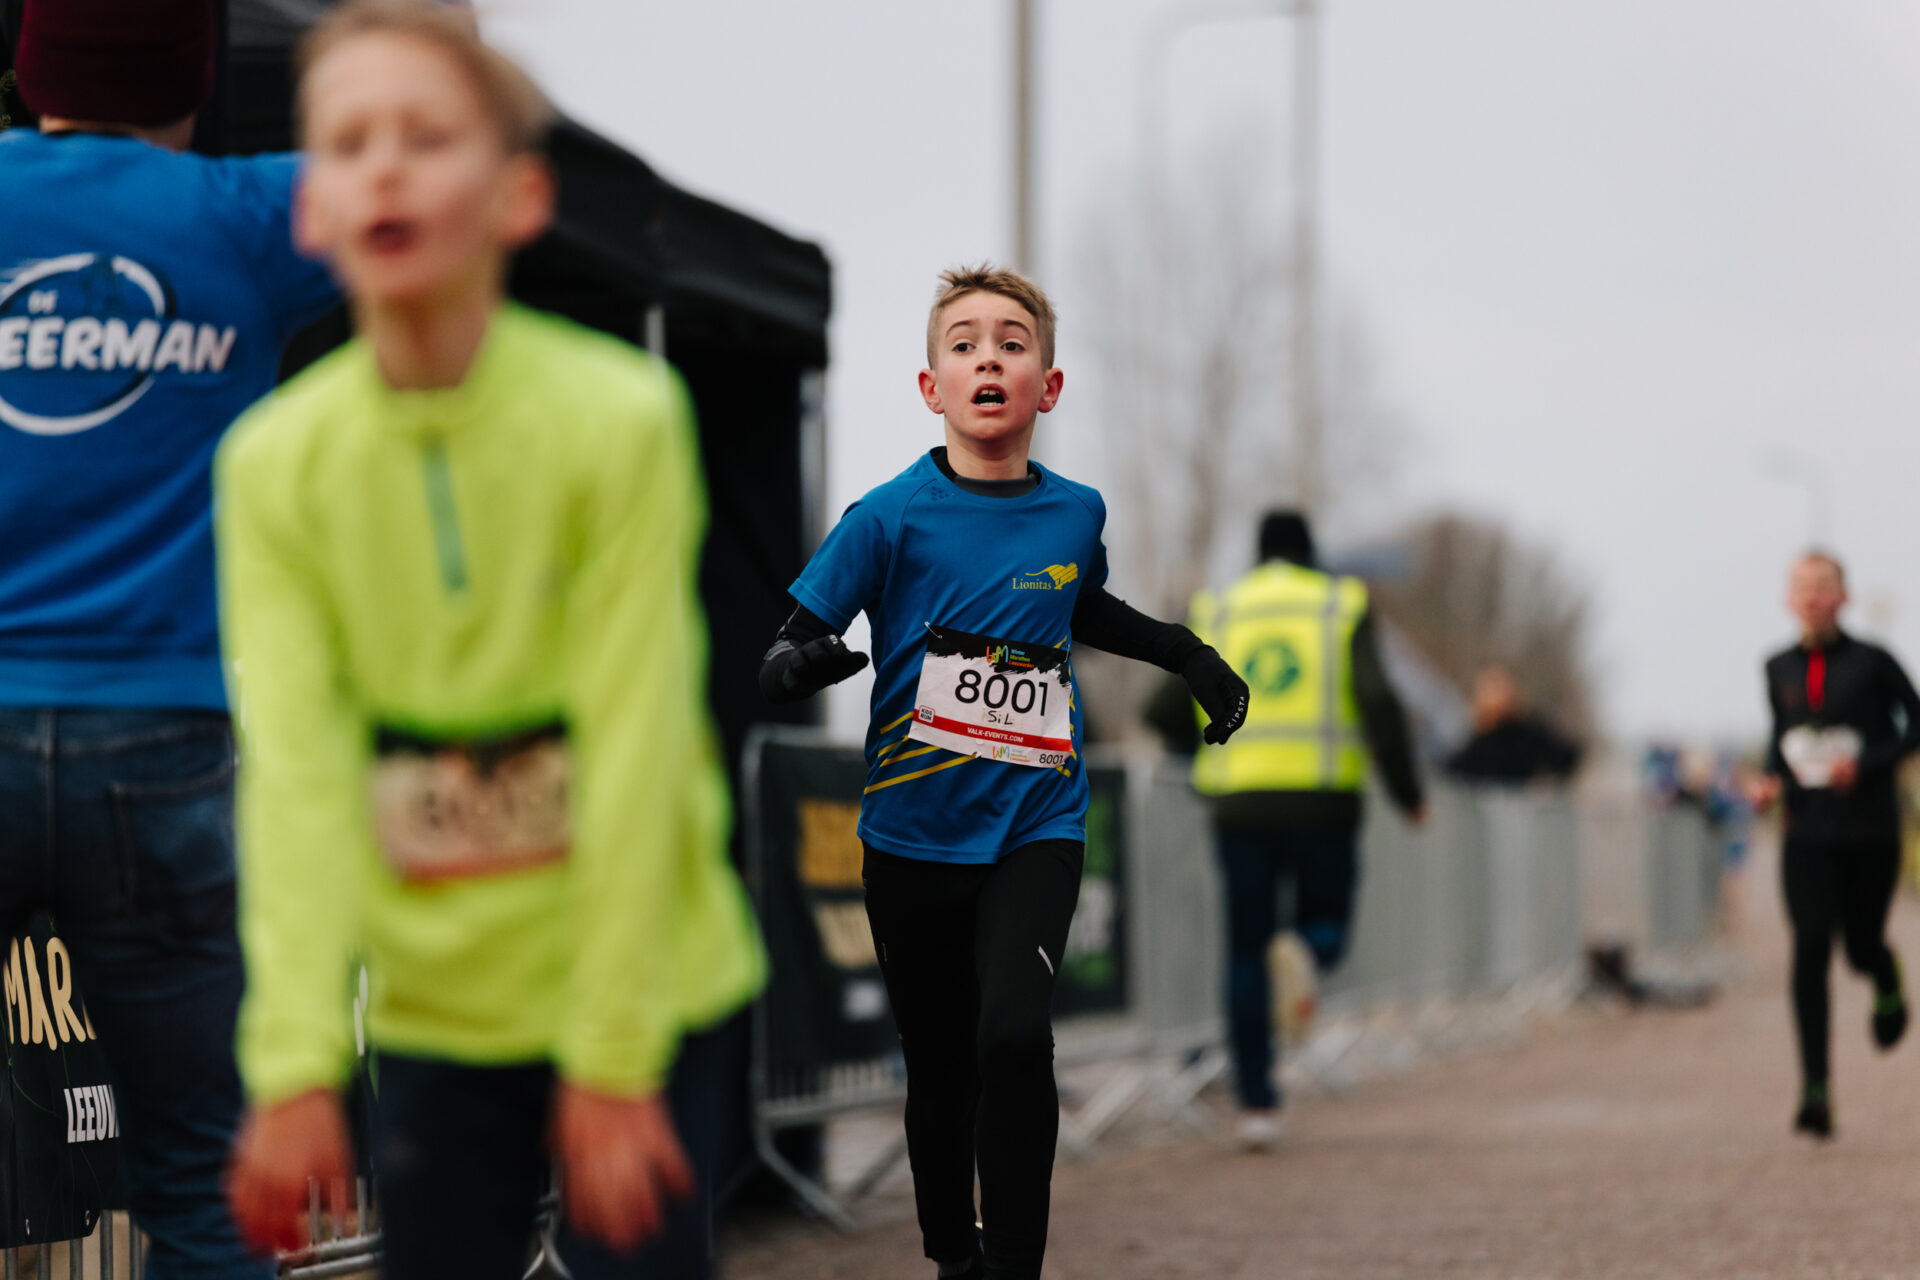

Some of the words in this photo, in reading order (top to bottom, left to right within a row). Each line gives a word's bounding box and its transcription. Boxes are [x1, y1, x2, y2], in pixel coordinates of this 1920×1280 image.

[1012, 577, 1052, 590] Lionitas
[954, 669, 1049, 717] 8001
[1226, 696, 1246, 729] KIPSTA
[967, 726, 1024, 744] VALK-EVENTS.COM
[1038, 753, 1064, 765] 8001
[3, 935, 97, 1051] MAR
